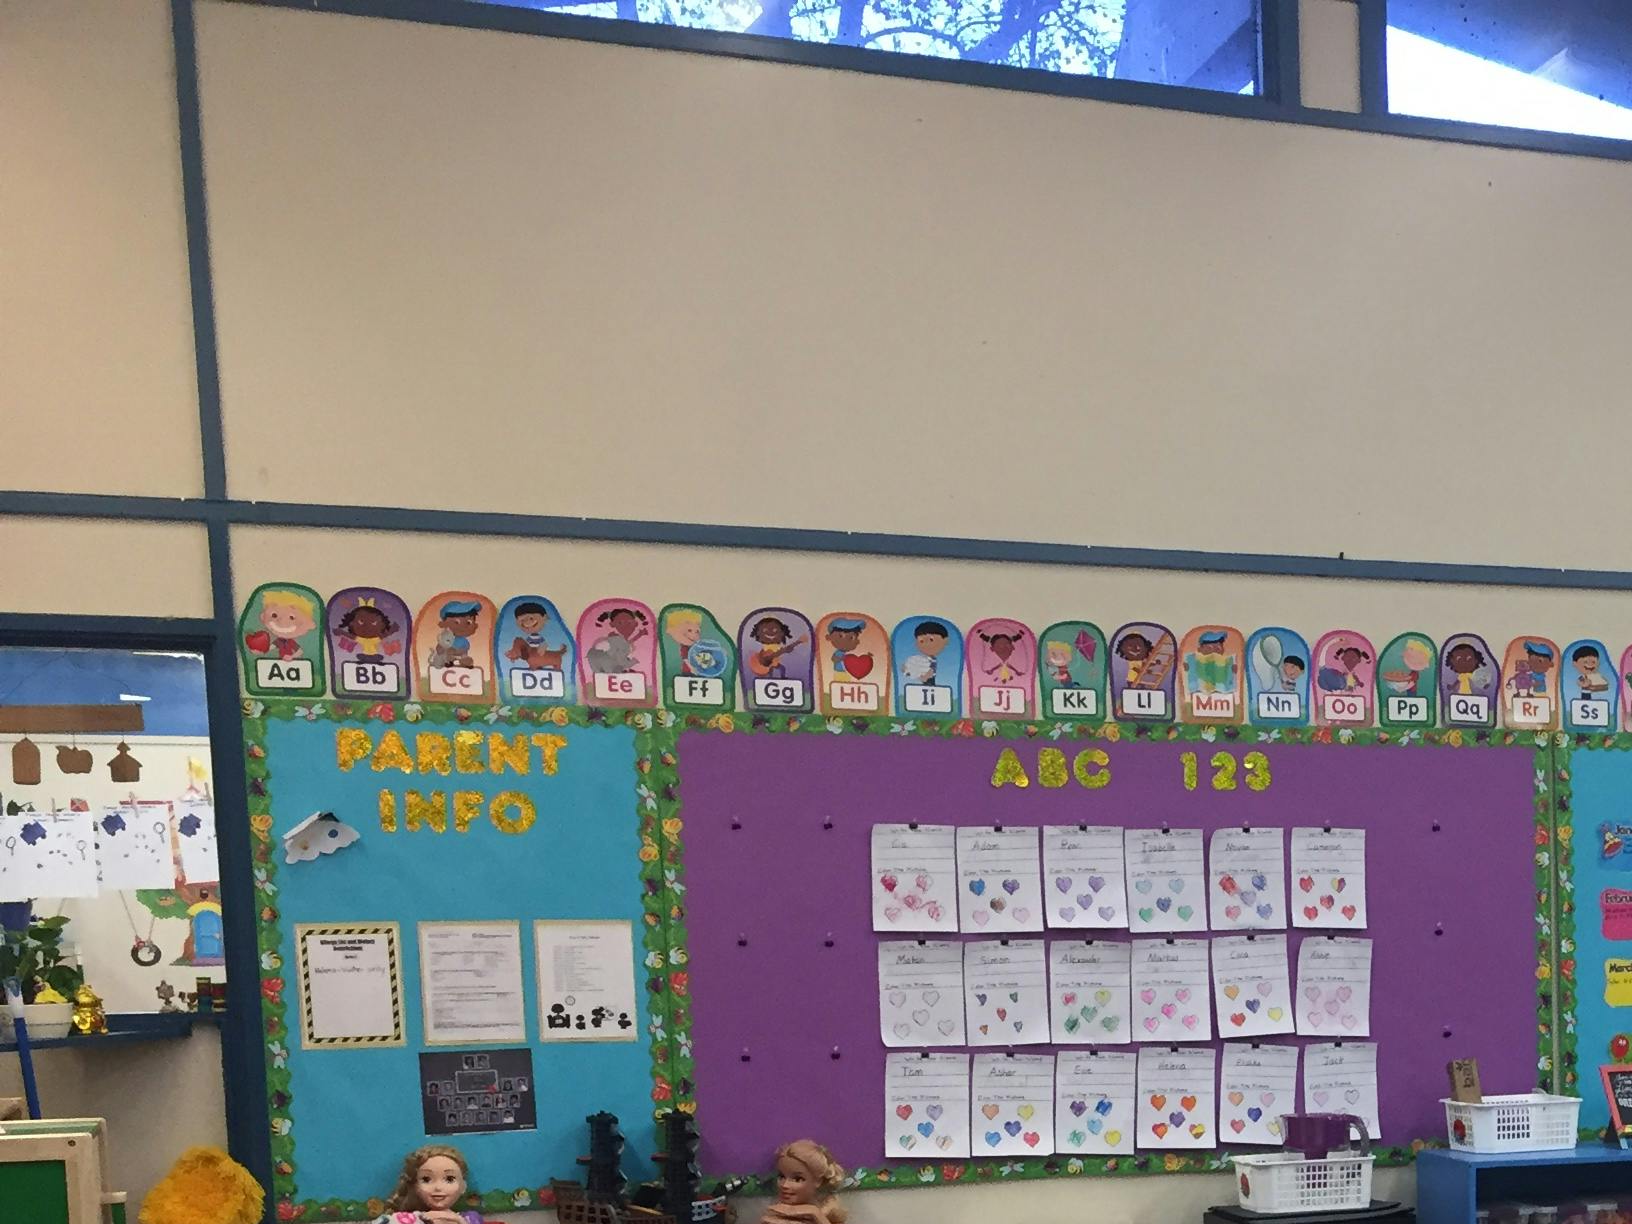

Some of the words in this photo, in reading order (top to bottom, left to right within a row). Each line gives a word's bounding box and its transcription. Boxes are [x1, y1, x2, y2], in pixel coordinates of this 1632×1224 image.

[267, 662, 301, 682] Aa
[355, 667, 386, 685] Bb
[441, 671, 471, 689] Cc
[521, 671, 553, 690] Dd
[607, 676, 633, 692] Ee
[687, 680, 709, 698] Ff
[764, 680, 795, 705] Gg
[839, 688, 869, 704] Hh
[921, 689, 936, 706] Ii
[993, 690, 1012, 711] Jj
[1063, 692, 1087, 709] Kk
[1137, 691, 1151, 708] Ll
[1196, 698, 1230, 712] Mm
[1266, 698, 1292, 712] Nn
[1332, 699, 1358, 714] Oo
[1397, 701, 1420, 720] Pp
[1456, 700, 1482, 720] Qq
[1523, 702, 1540, 717] Rr
[1580, 705, 1600, 722] Ss
[335, 727, 567, 775] PARENT
[990, 747, 1112, 789] ABC
[1180, 751, 1273, 791] 123
[376, 788, 538, 834] INFO
